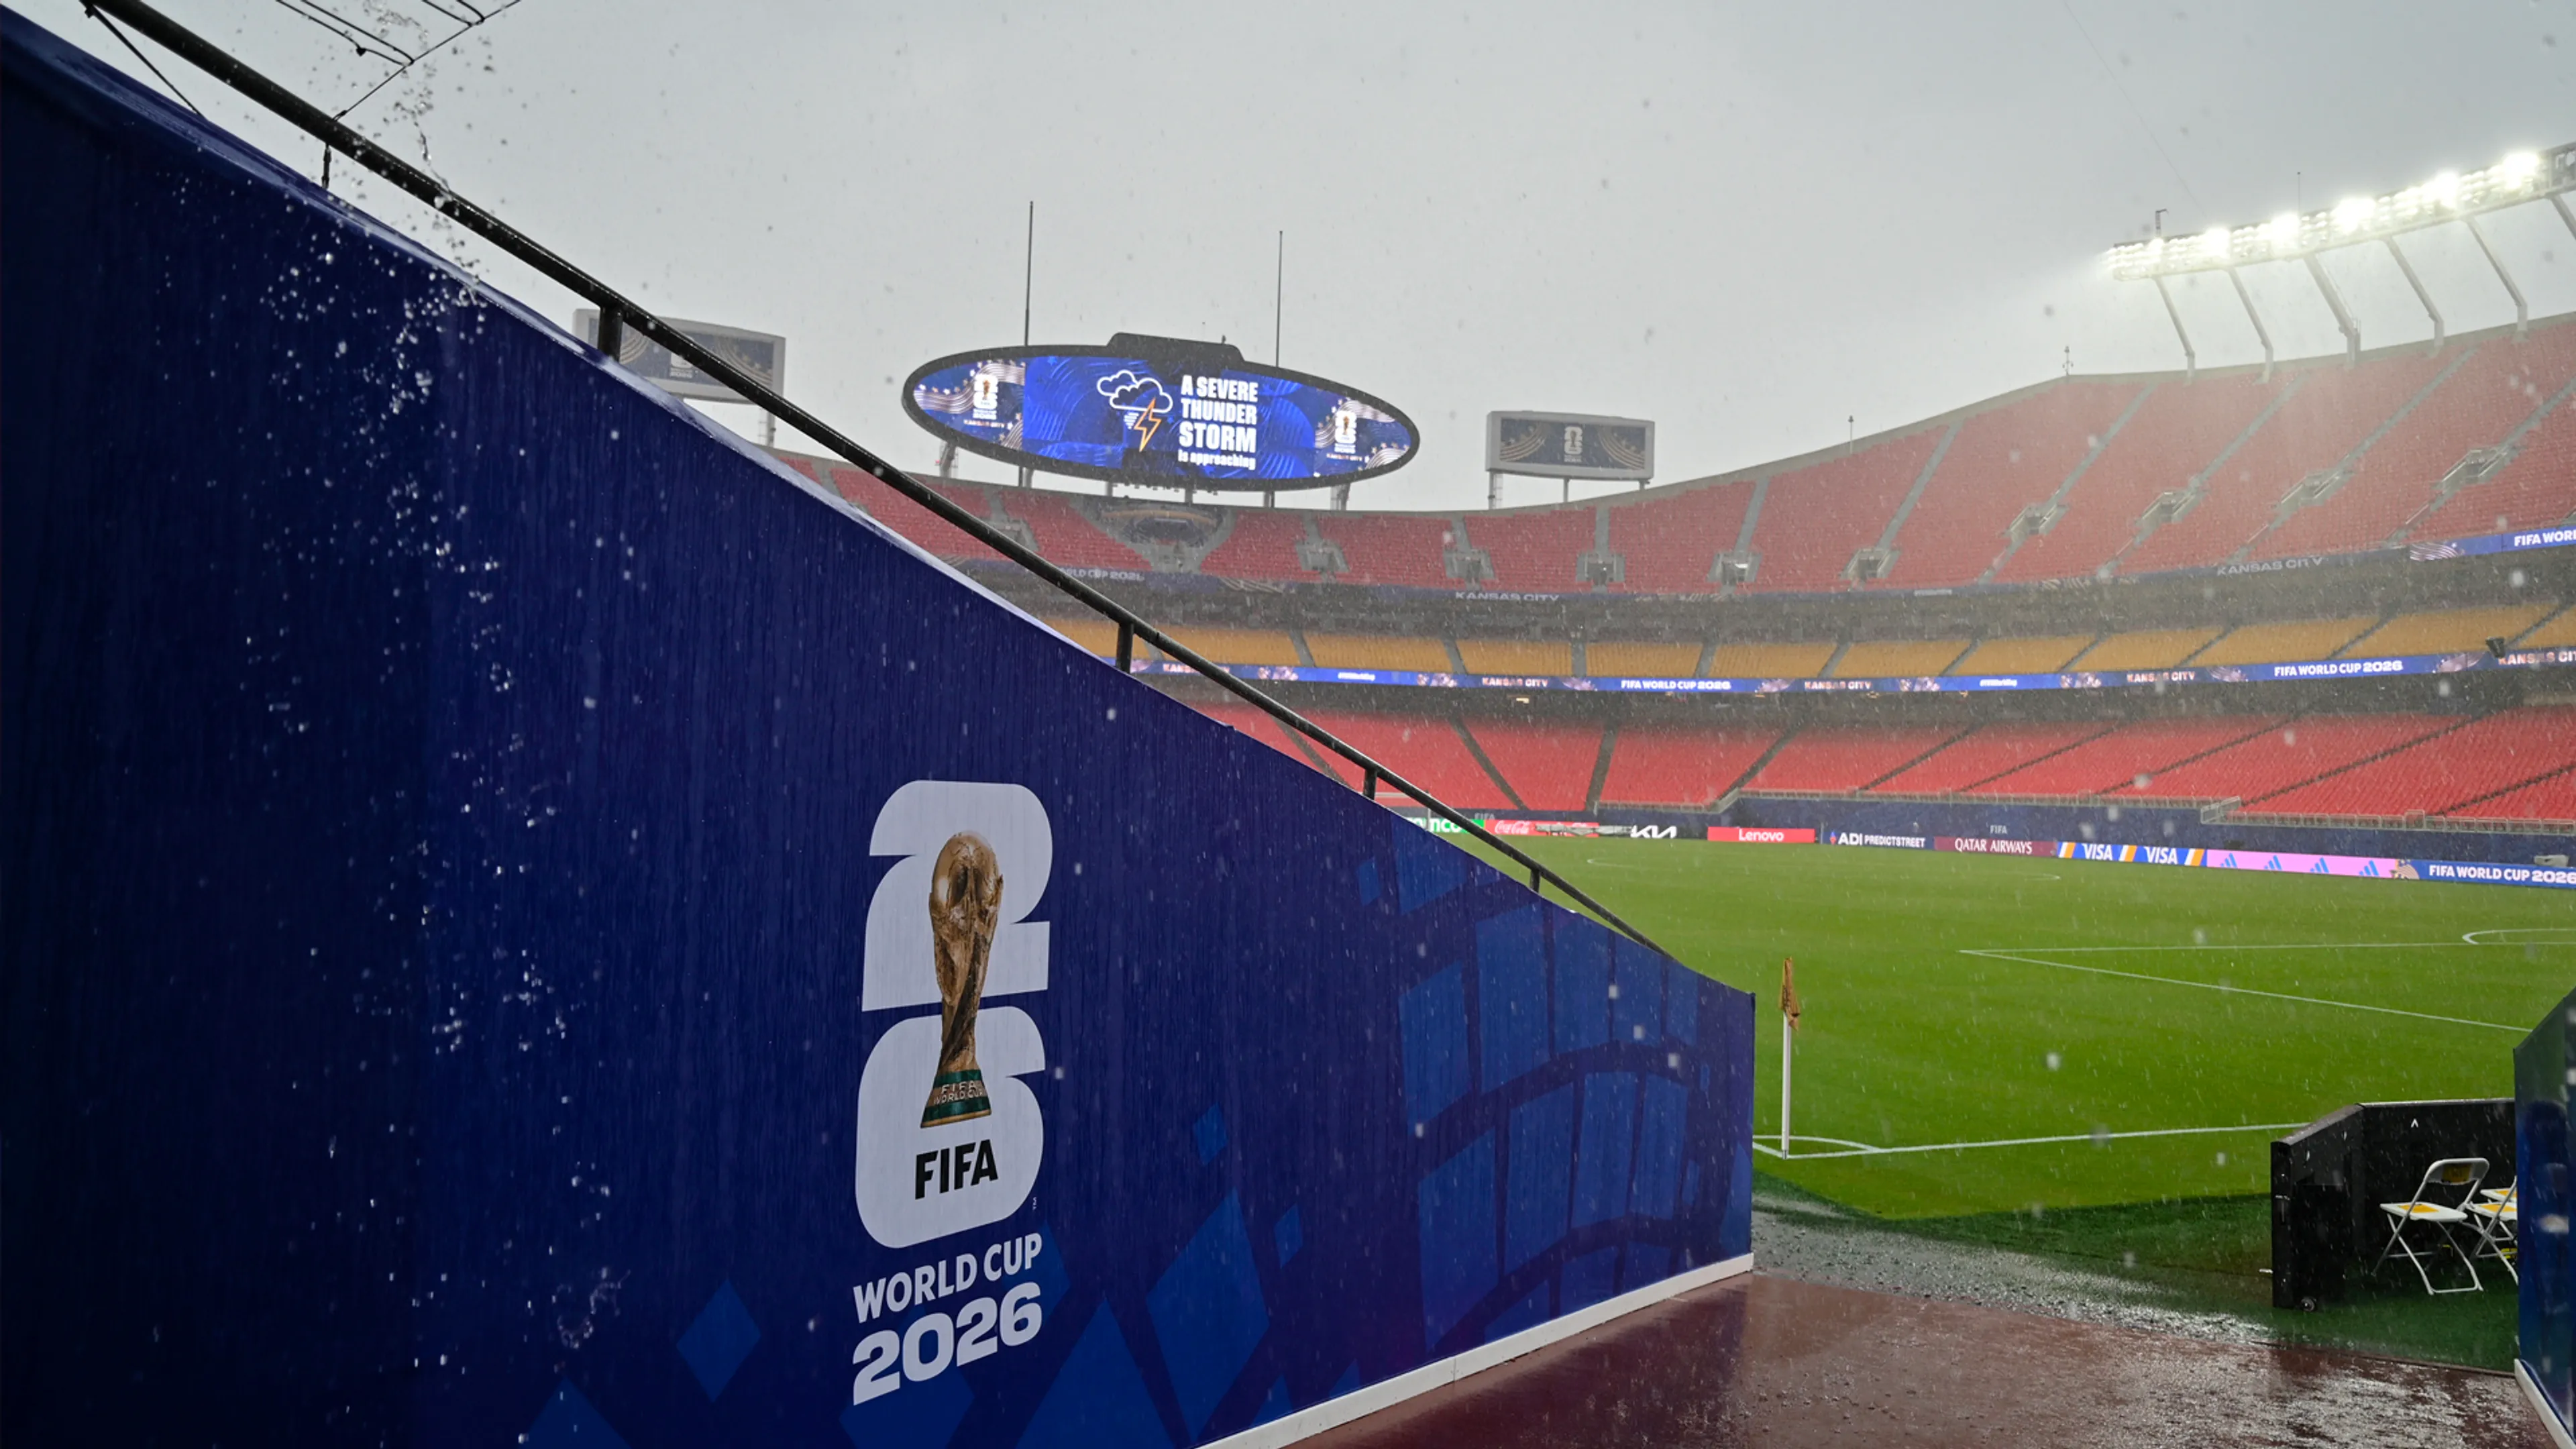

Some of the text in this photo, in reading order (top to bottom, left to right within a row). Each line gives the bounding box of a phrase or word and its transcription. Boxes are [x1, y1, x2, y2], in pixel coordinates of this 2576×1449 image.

[1181, 374, 1258, 402] A SEVERE
[1181, 398, 1257, 425] THUNDER
[1179, 421, 1257, 453] STORM
[1190, 452, 1256, 470] approaching
[2514, 534, 2542, 547] FIFA
[2216, 557, 2323, 576] KANSAS CITY
[1455, 592, 1560, 602] KANSAS CITY
[2171, 671, 2196, 682] CITY
[2274, 660, 2404, 678] FIFA WORLD CUP 2026
[1525, 678, 1549, 688] CITY
[1621, 680, 1732, 690] FIFA WORLD CUP 2026
[1847, 680, 1872, 690] CITY
[1738, 828, 1784, 842] Lenovo
[1990, 824, 2008, 835] FIFA
[1838, 832, 1926, 848] ADI PREDICTSTREET
[1955, 837, 2033, 855] QATAR AIRWAYS
[2081, 843, 2113, 861] VISA
[2143, 846, 2179, 865] VISA
[2429, 865, 2576, 885] FIFA WORLD CUP 2026
[941, 1080, 977, 1095] FIFA
[933, 1090, 965, 1106] WORLD
[915, 1139, 999, 1200] FIFA
[853, 1232, 1042, 1324] WORLD CUP
[853, 1281, 1042, 1406] 2026
